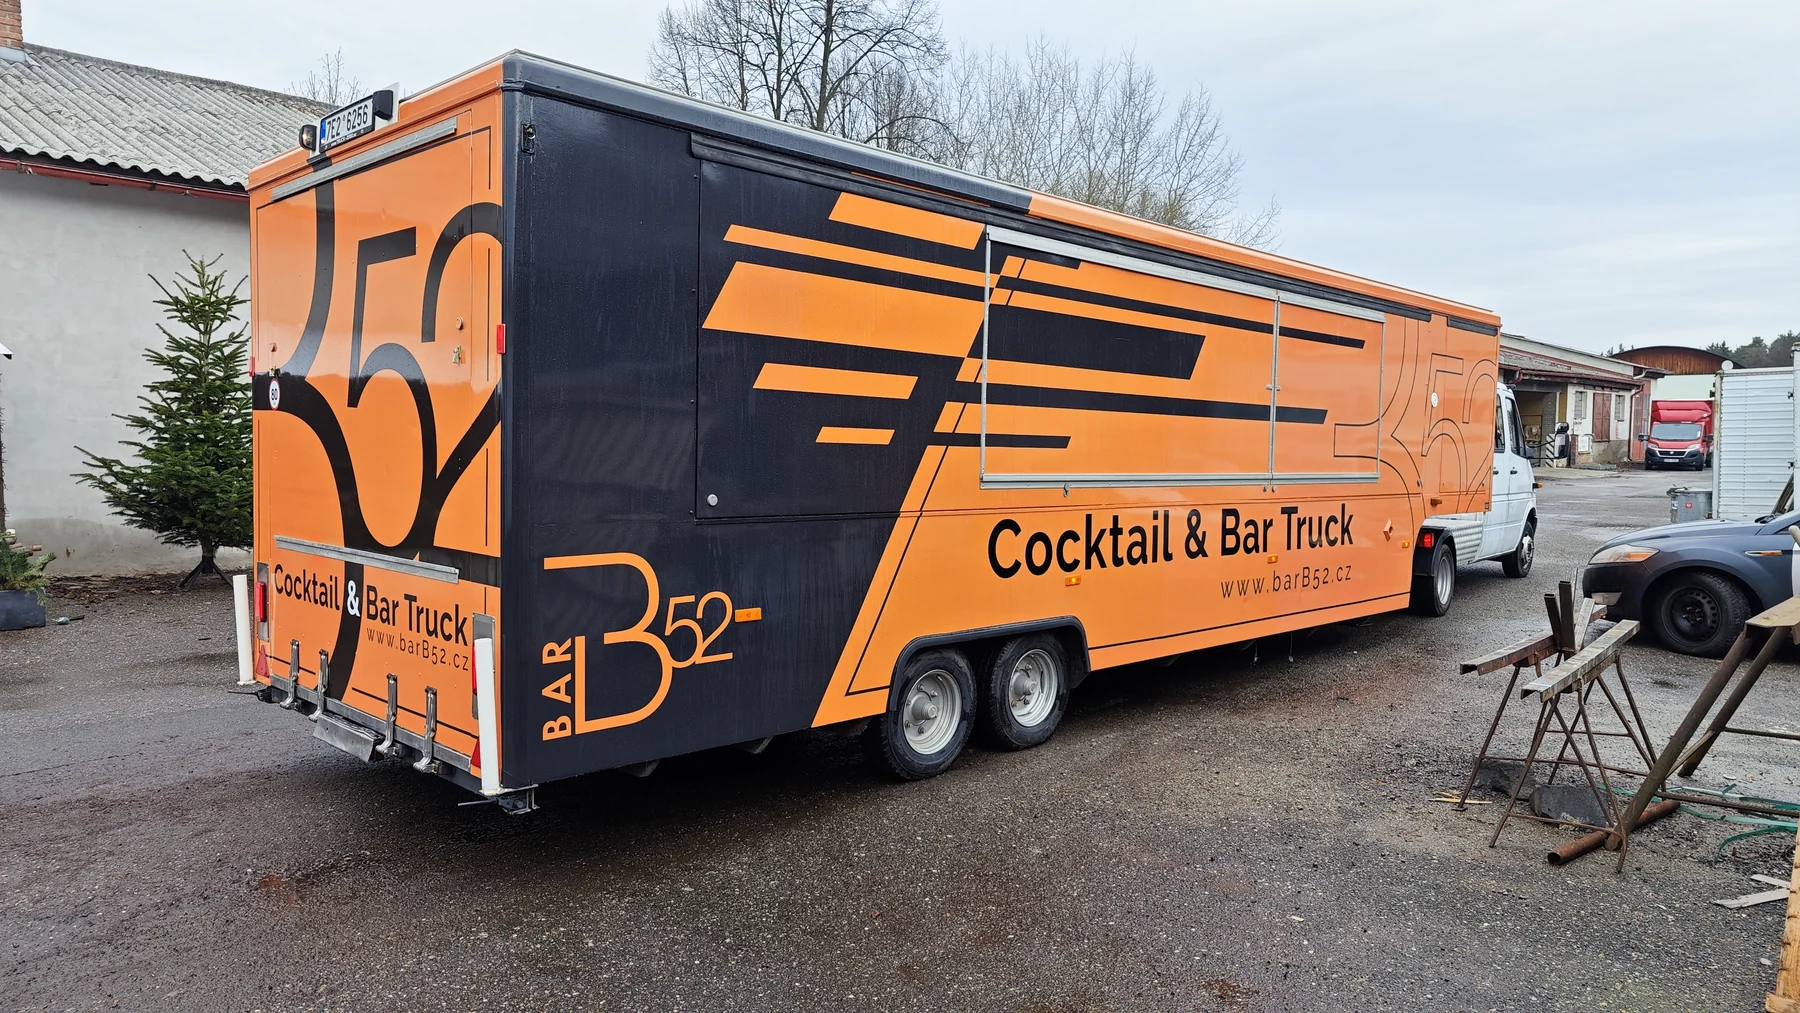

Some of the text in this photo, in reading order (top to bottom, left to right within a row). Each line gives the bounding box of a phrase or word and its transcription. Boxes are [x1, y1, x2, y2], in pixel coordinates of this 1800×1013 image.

[327, 116, 341, 141] 7E2
[346, 104, 368, 131] 6256
[271, 388, 278, 400] 80
[988, 503, 1353, 579] Cocktail & Bar Truck
[1220, 562, 1352, 599] www.barB52.cz
[274, 564, 468, 647] Cocktail & Bar Truck
[366, 627, 469, 671] www.barB52.cz
[542, 637, 572, 741] BAR
